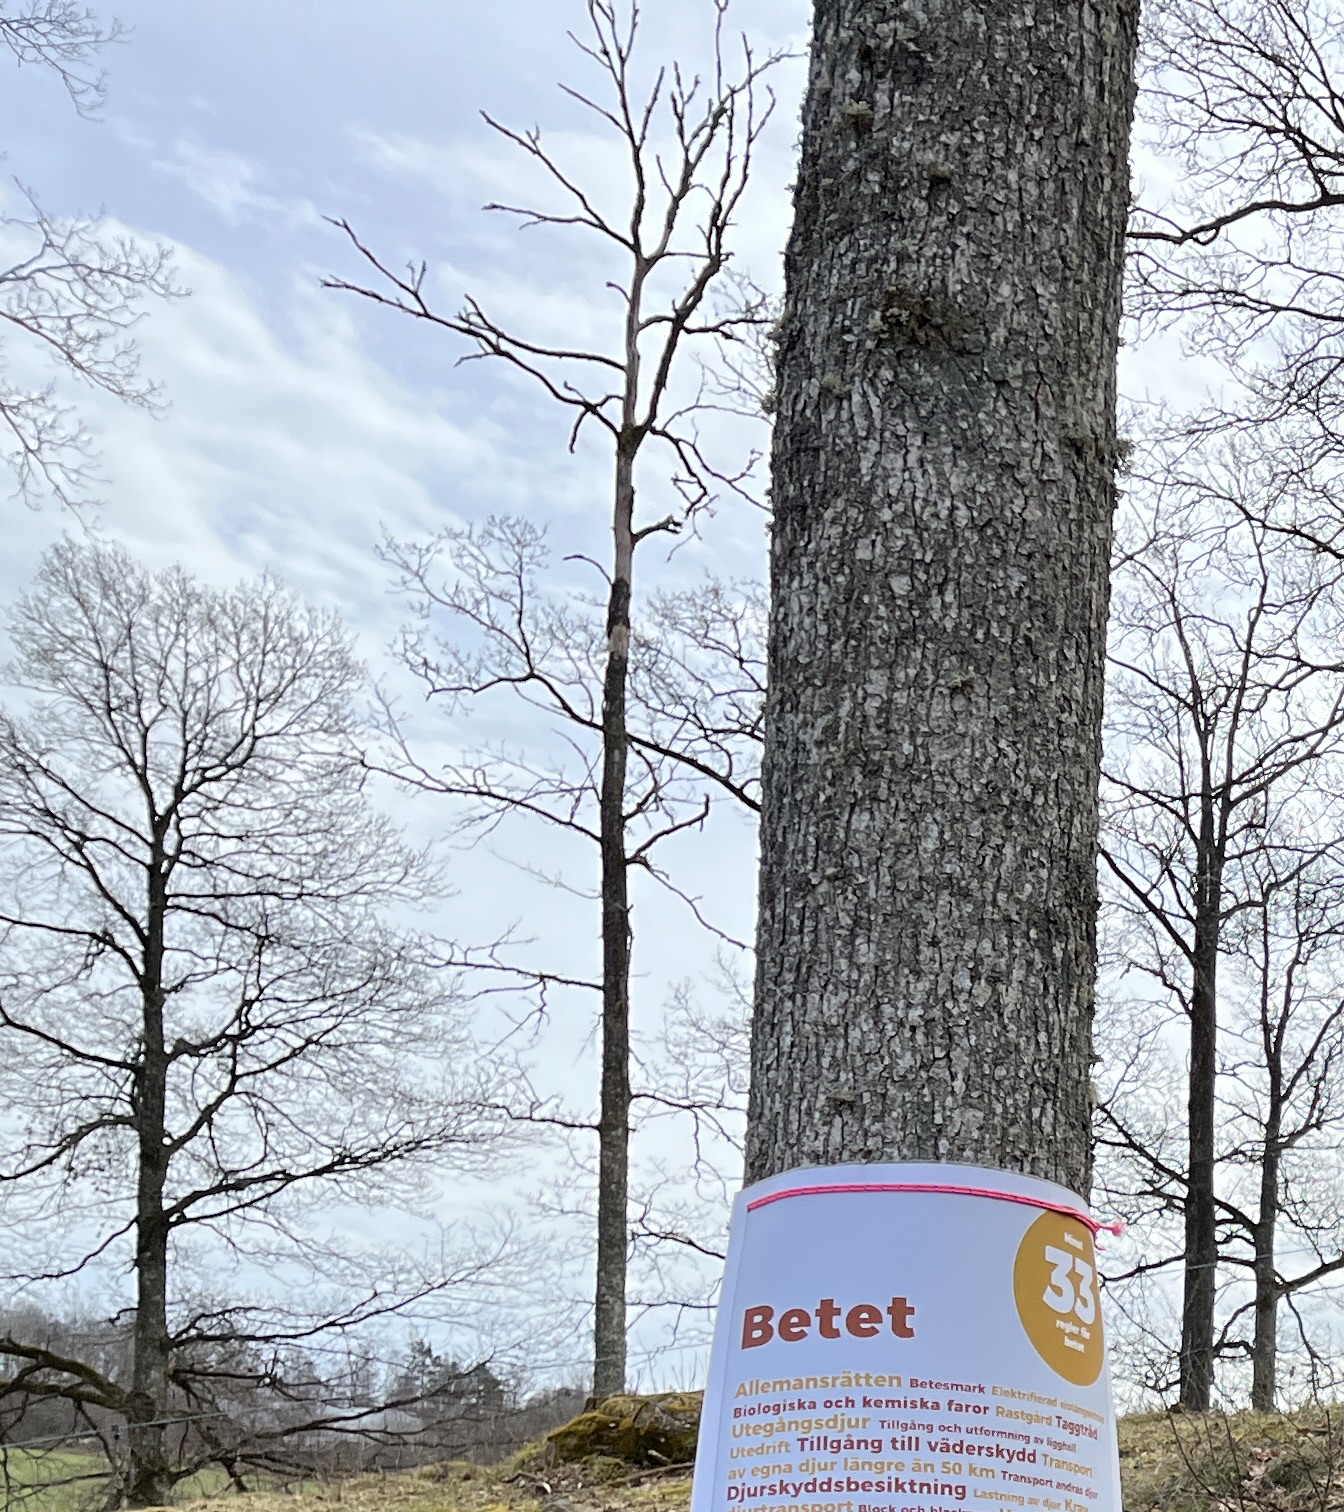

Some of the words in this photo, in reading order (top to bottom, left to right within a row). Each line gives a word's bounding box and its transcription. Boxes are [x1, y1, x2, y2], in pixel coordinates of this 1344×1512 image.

[1042, 1245, 1096, 1325] 33
[741, 1296, 916, 1350] Betet
[734, 1370, 902, 1399] Allemansrätten
[909, 1378, 985, 1394] Betesmark
[992, 1386, 1057, 1407] Elektrifierad
[732, 1413, 870, 1438] Utegångsdjur
[879, 1420, 933, 1433] Tillgång
[938, 1423, 962, 1433] och
[966, 1426, 1030, 1444] utformning
[1034, 1437, 1044, 1446] av
[733, 1399, 817, 1419] Biologiska
[824, 1396, 855, 1408] och
[863, 1396, 941, 1411] kemiska
[947, 1399, 990, 1416] faror
[995, 1405, 1052, 1426] Rastgård
[1055, 1415, 1098, 1440] Taggtråd
[728, 1467, 746, 1480] av
[751, 1463, 793, 1479] egna
[799, 1458, 837, 1476] djur
[843, 1456, 905, 1475] längre
[911, 1457, 935, 1473] än
[941, 1461, 962, 1475] 50
[968, 1463, 996, 1479] km
[1001, 1470, 1053, 1488] Transport
[730, 1440, 790, 1459] Utedrift
[797, 1433, 882, 1454] Tillgång
[891, 1436, 919, 1452] till
[927, 1438, 1037, 1464] väderskydd
[1042, 1453, 1094, 1478] Transport
[727, 1476, 967, 1503] Djurskyddsbesiktning
[973, 1488, 1024, 1506] Lastning
[1027, 1496, 1040, 1506] av
[1043, 1497, 1061, 1510] djur
